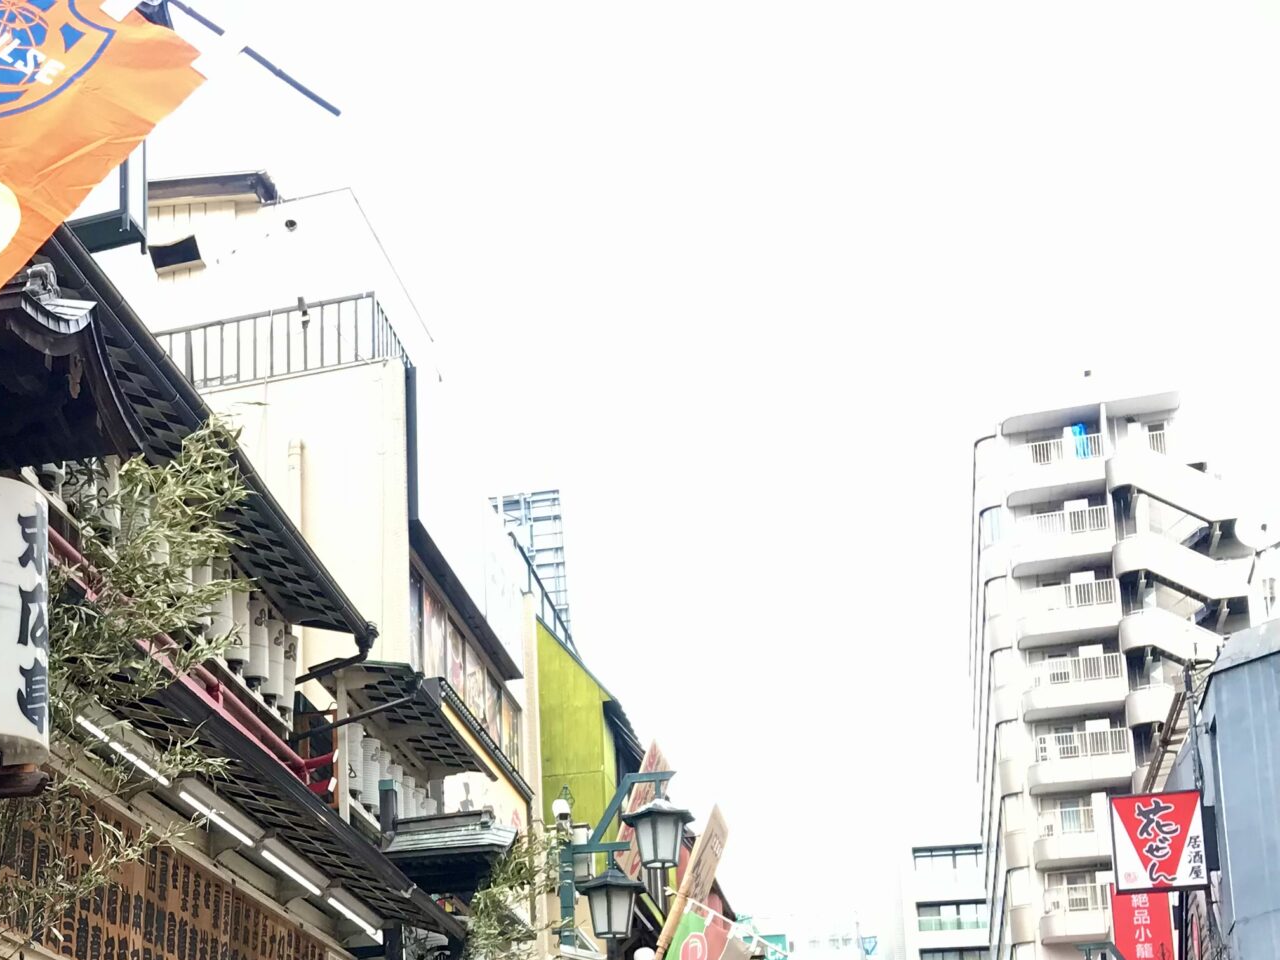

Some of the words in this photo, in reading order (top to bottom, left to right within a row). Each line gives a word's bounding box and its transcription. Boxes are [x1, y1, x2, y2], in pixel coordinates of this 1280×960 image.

[1135, 798, 1180, 883] 花ぜん
[1187, 835, 1205, 880] 居酒屋
